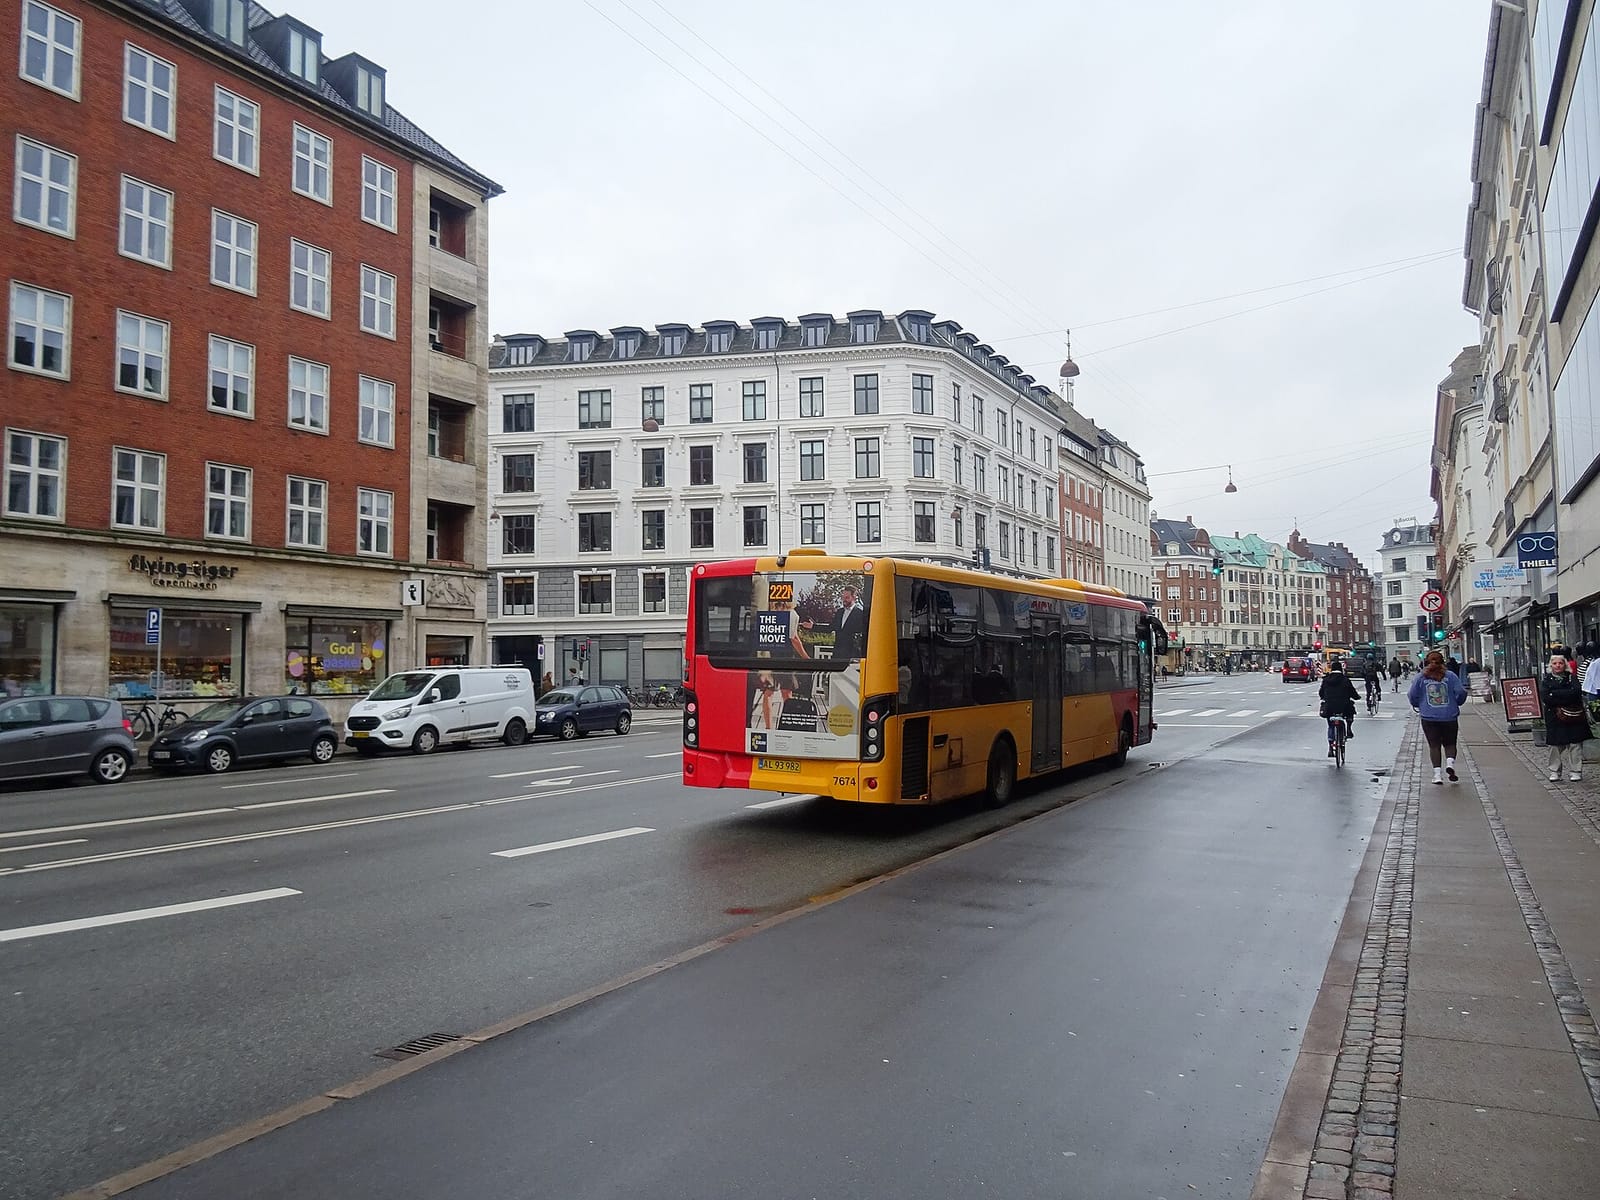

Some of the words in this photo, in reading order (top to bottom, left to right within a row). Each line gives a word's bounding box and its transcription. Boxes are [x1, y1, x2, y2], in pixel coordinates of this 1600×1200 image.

[129, 554, 188, 577] flying
[152, 579, 218, 591] copenhagen
[149, 611, 158, 629] P
[760, 615, 777, 624] THE
[760, 625, 787, 633] RIGHT
[760, 634, 786, 643] MOVE
[329, 642, 355, 655] God
[1509, 686, 1533, 696] -20%
[763, 760, 773, 769] AL
[775, 761, 784, 769] 93
[786, 762, 800, 771] 982
[833, 776, 857, 786] 7674
